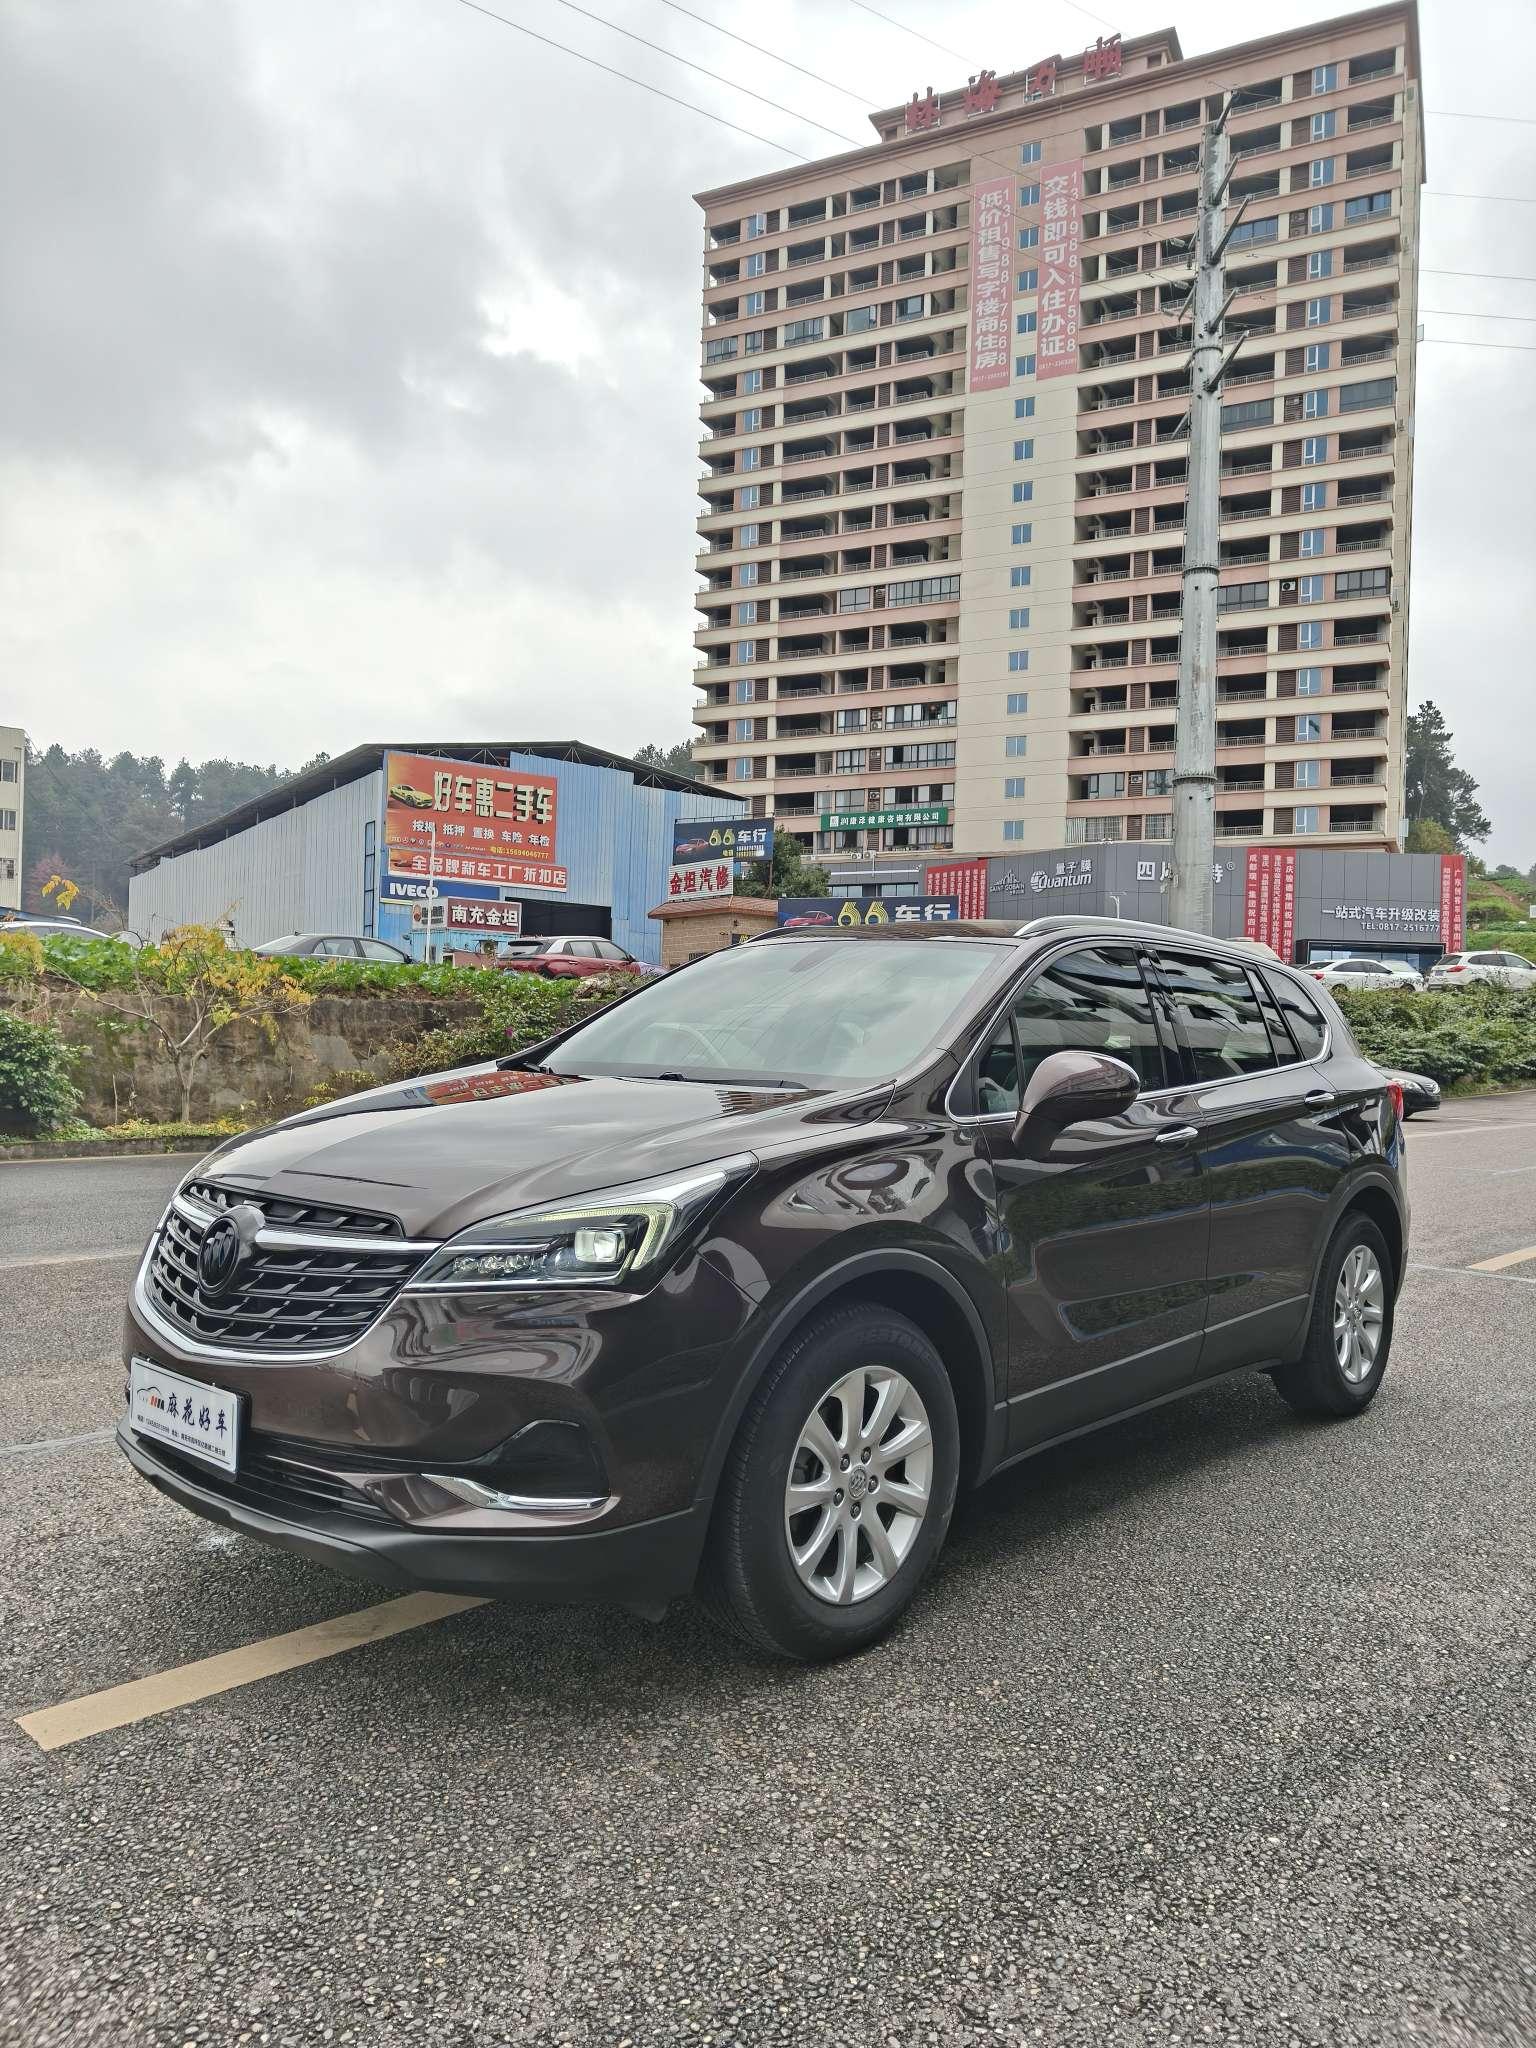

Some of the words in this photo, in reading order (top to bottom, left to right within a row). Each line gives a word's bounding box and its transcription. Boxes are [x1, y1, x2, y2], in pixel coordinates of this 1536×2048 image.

[999, 187, 1011, 366] 13198817568
[1040, 175, 1069, 357] 交钱即可入住办证
[1066, 170, 1079, 353] 13198817568
[974, 190, 1001, 369] 低价租售写字楼商住房
[433, 771, 554, 824] 好车惠二手车
[412, 819, 436, 832] 按揭
[442, 823, 466, 837] 抵押
[472, 826, 495, 840] 置换
[501, 830, 523, 844] 车险
[528, 834, 550, 847] 年检
[412, 855, 567, 885] 全品牌新车工厂折扣店
[670, 865, 729, 895] 金坦汽修
[1037, 873, 1093, 889] Quantum
[388, 882, 439, 898] IVECO
[451, 904, 519, 927] 南充金坦
[1321, 905, 1440, 921] 一站式汽车升级改装
[166, 1391, 228, 1440] 麻花好车
